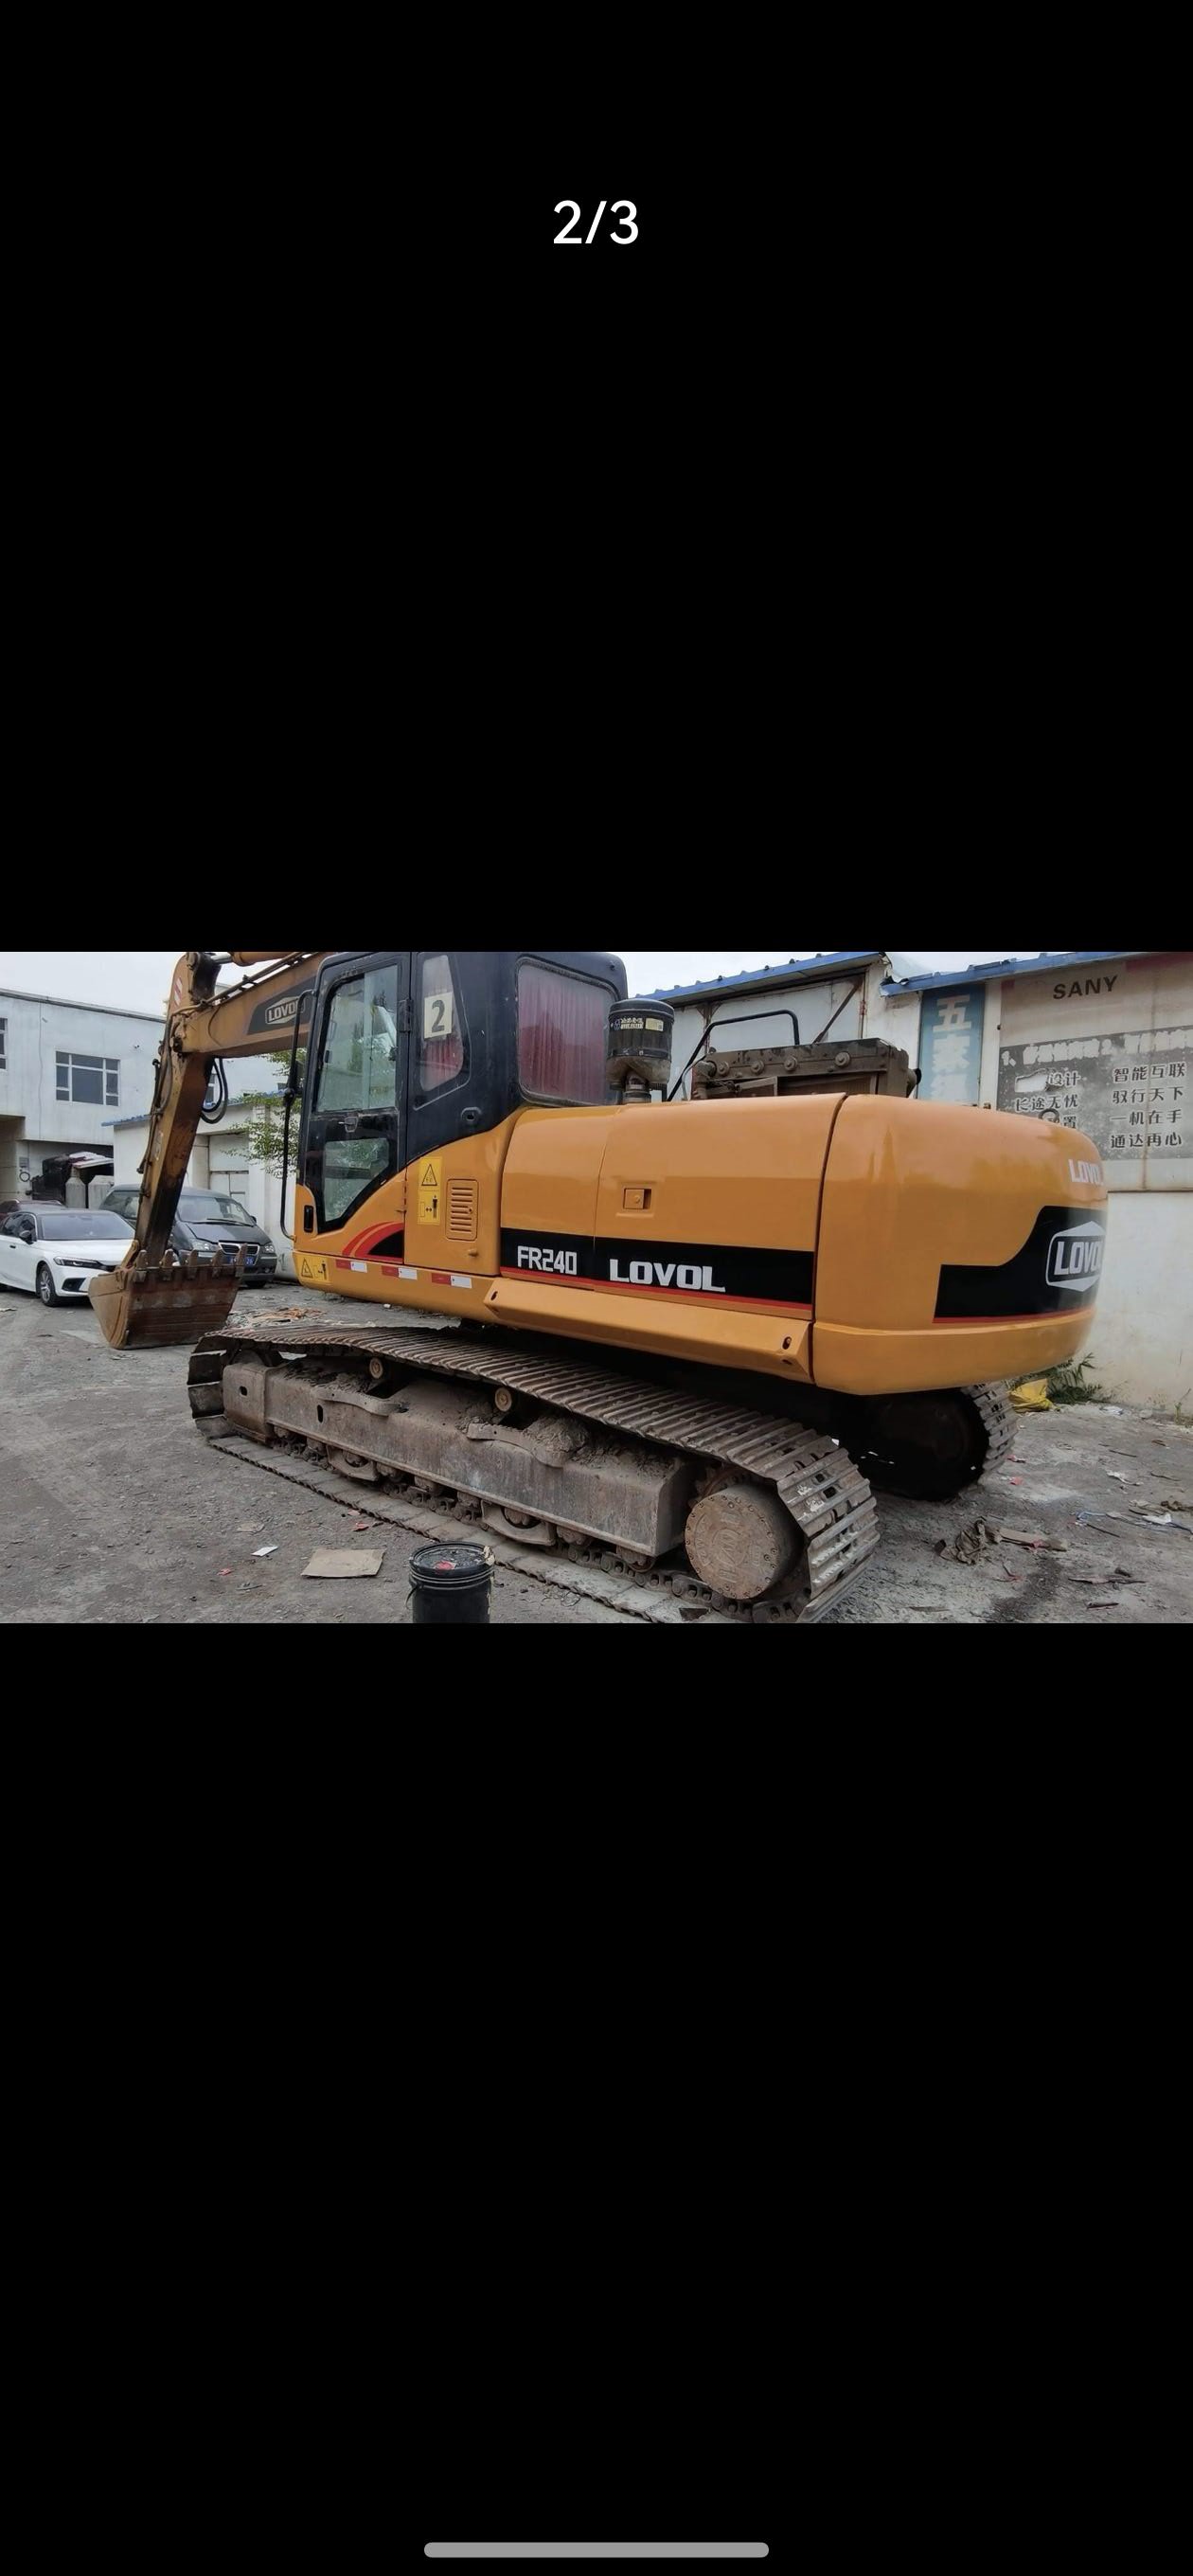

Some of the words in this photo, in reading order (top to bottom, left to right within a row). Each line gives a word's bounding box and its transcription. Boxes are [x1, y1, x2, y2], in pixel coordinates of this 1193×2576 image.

[1053, 975, 1118, 1000] SANY
[268, 1000, 297, 1022] LOVO
[432, 999, 445, 1033] 2
[1113, 1063, 1185, 1082] 智能互联
[1016, 1094, 1078, 1112] 长途无忧
[1112, 1085, 1184, 1104] 驭行天下
[1110, 1108, 1183, 1126] 一机在手
[518, 1245, 578, 1276] FR240
[1054, 1241, 1102, 1276] LOVO
[610, 1259, 726, 1293] LOVOL
